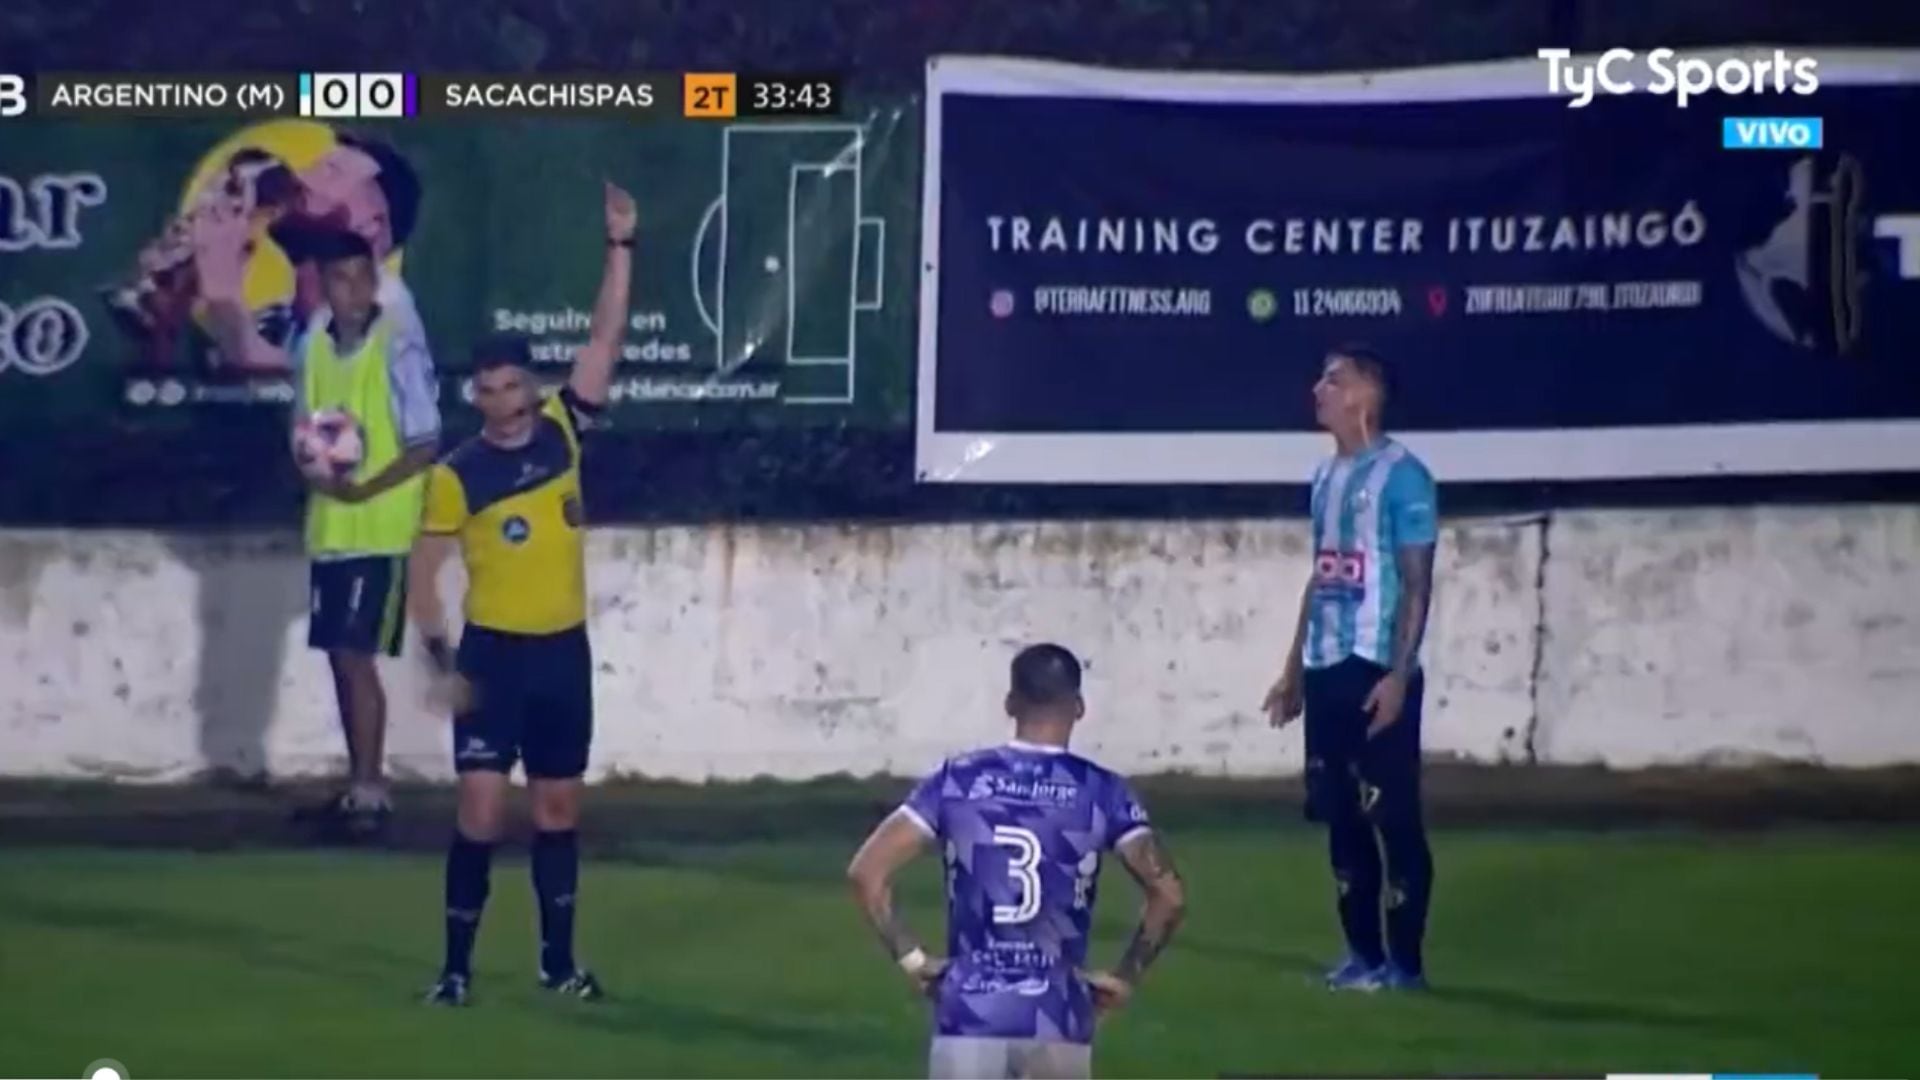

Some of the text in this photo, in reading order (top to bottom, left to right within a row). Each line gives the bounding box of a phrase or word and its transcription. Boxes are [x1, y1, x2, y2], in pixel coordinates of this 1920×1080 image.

[986, 201, 1706, 254] TRAINING CENTER ITUZAINGÓ
[632, 312, 666, 331] en
[622, 339, 691, 362] edes
[992, 825, 1042, 924] 3
